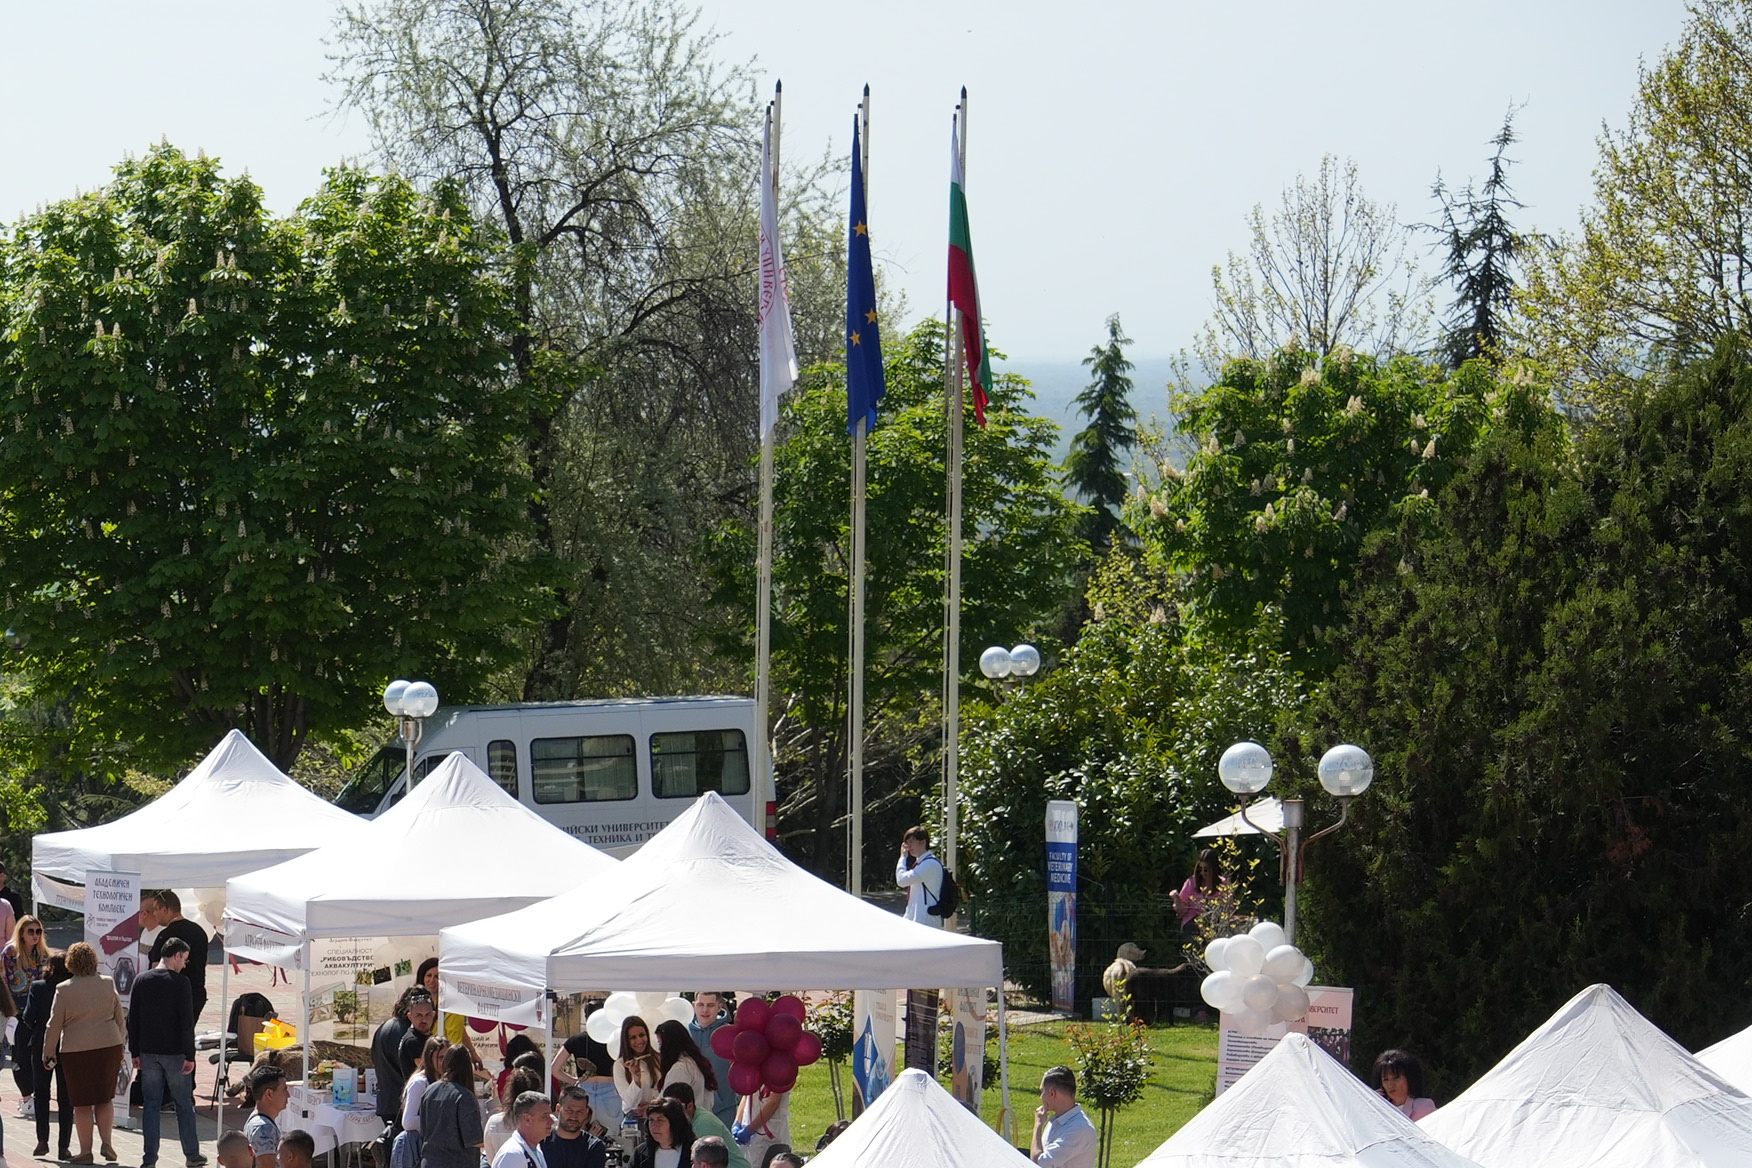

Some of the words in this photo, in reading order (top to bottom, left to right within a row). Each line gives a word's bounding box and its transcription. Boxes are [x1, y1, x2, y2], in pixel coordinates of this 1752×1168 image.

[561, 824, 598, 835] ИЙСКИ
[588, 835, 632, 844] ТЕХНИКА
[635, 834, 643, 842] И
[1048, 862, 1073, 872] VETERINARY
[95, 878, 130, 888] АКАДЕМИЧЕН
[1050, 873, 1071, 883] MEDICINE
[93, 890, 133, 901] ТЕХНОЛОГИЧЕН
[98, 903, 126, 913] КОМПЛЕКС
[1309, 1005, 1339, 1015] ВЕРСИТЕТ
